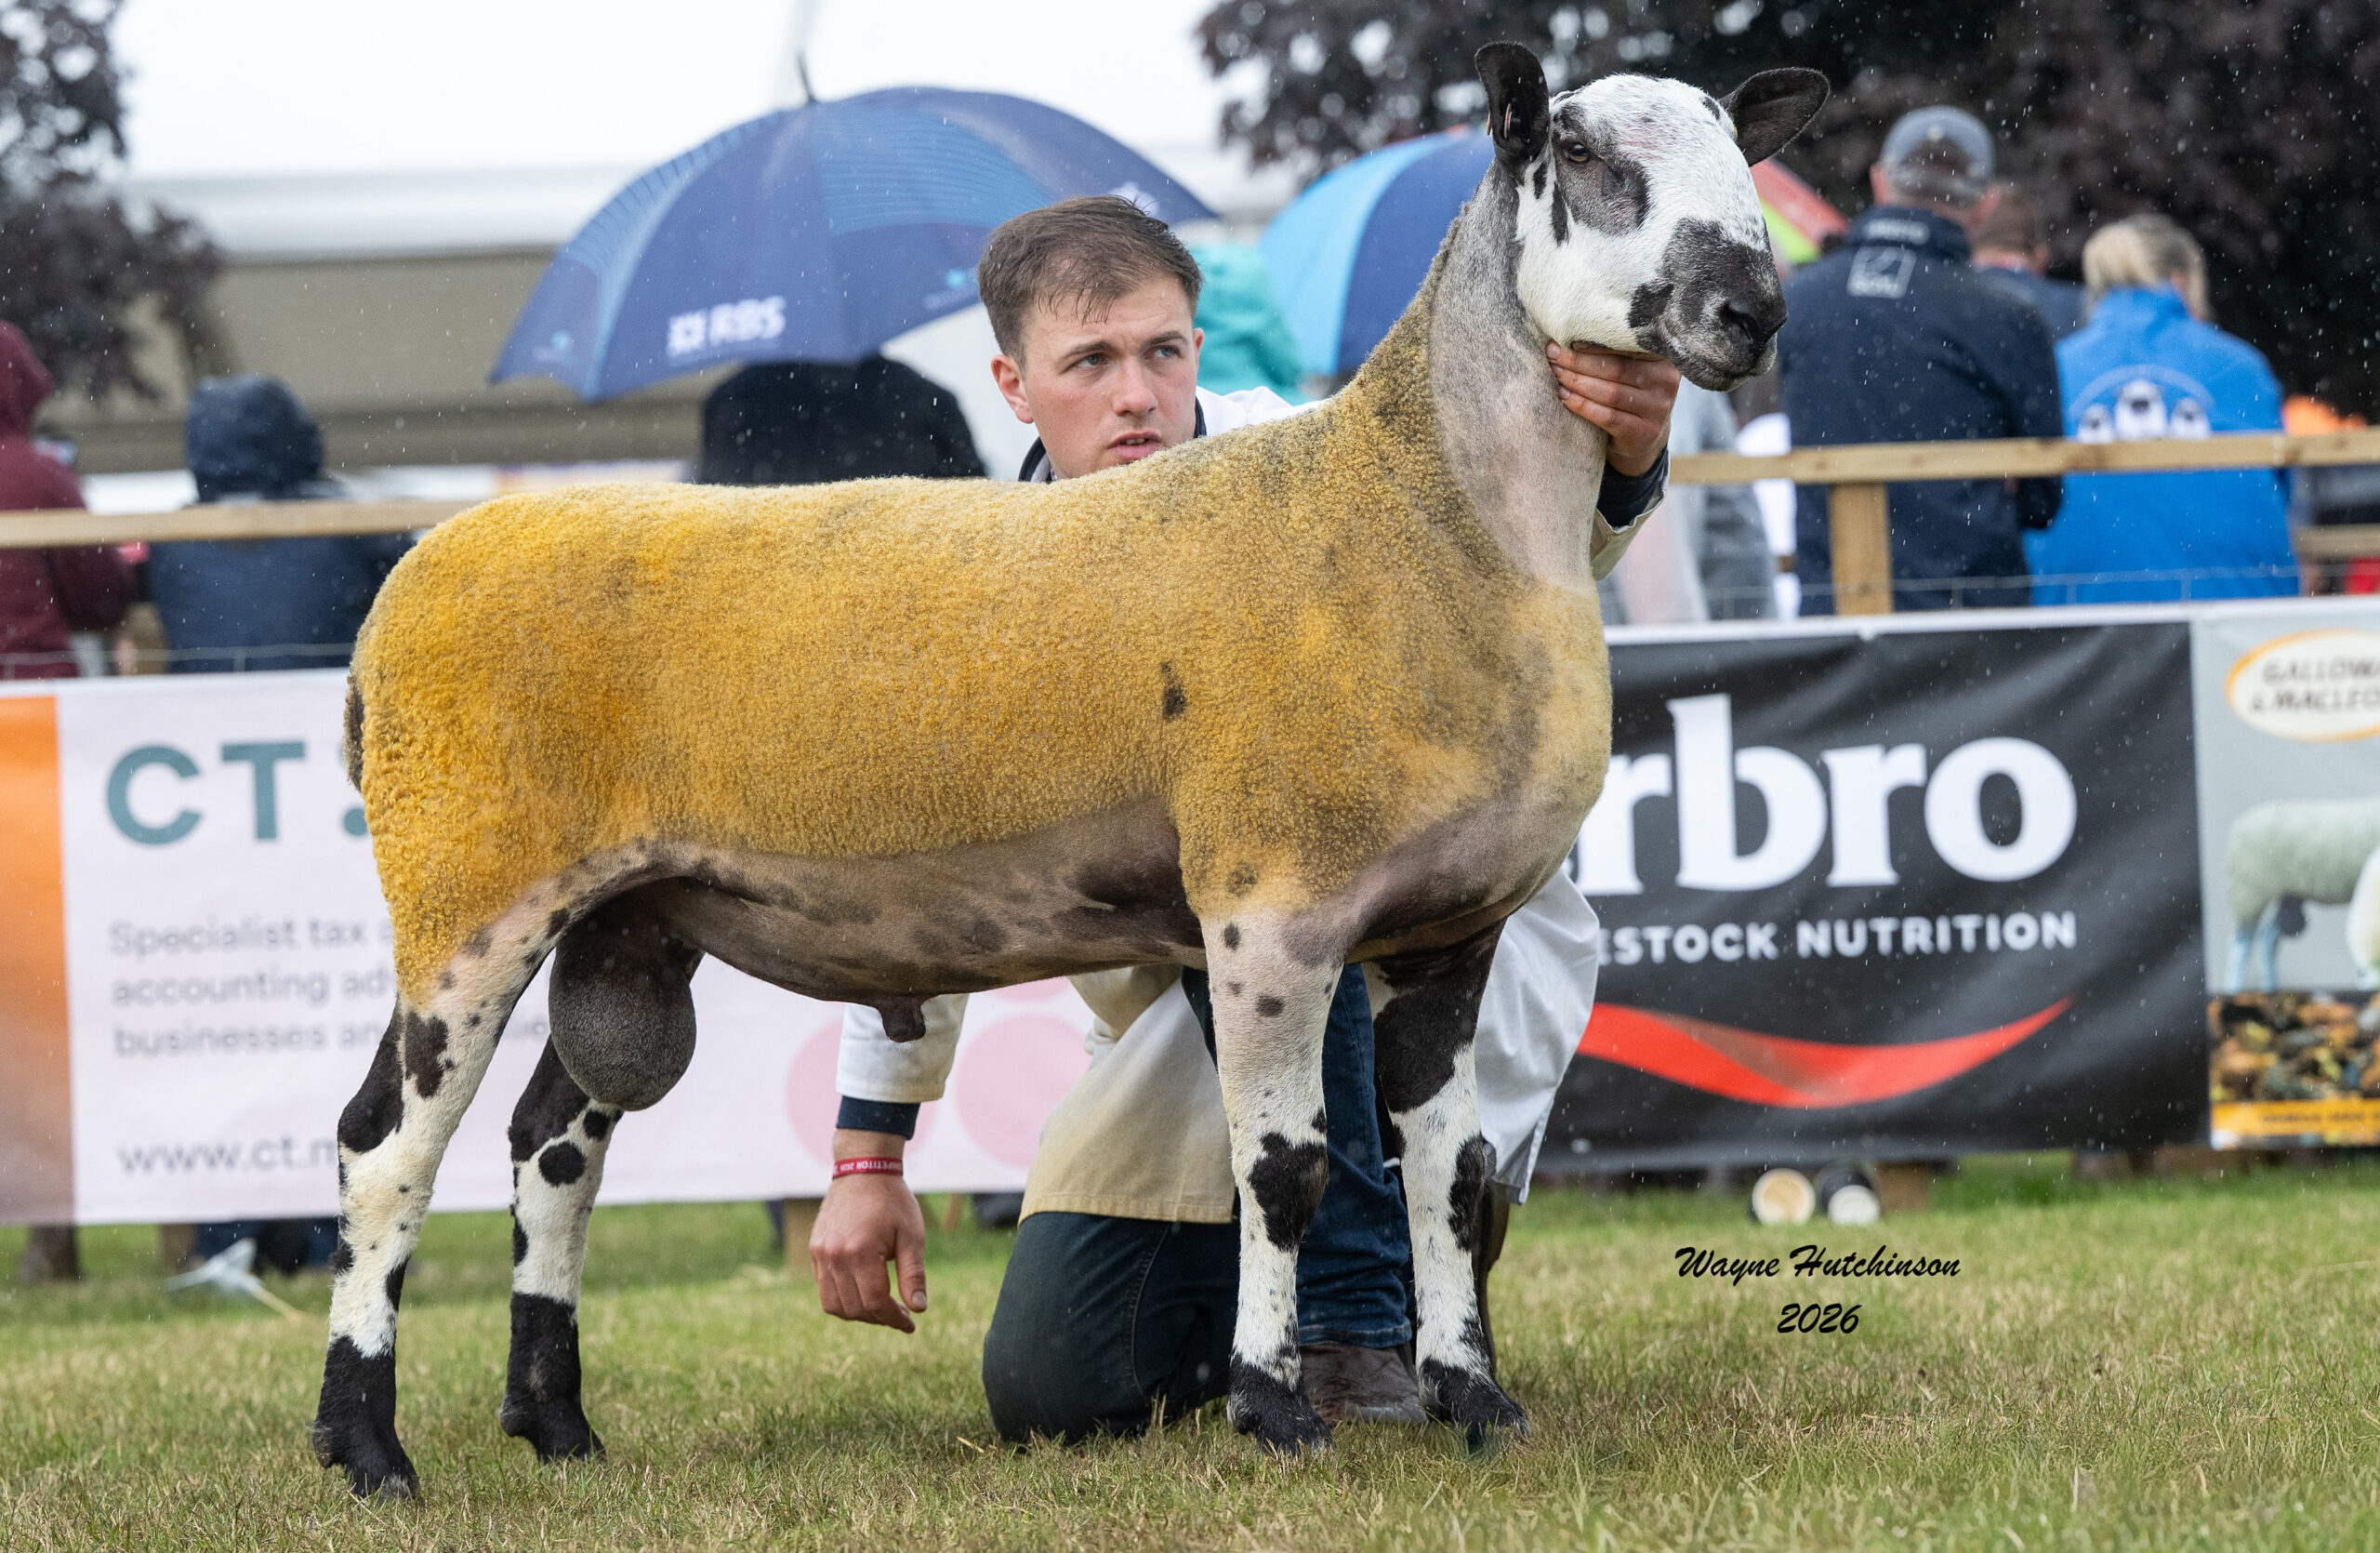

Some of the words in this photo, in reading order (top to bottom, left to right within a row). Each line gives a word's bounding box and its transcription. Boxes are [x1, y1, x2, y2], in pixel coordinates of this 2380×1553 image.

[2275, 686, 2380, 712] MACLEO
[1566, 693, 2078, 896] rbro
[111, 916, 297, 960] Specialist
[309, 918, 367, 947] tax
[1796, 910, 2078, 959] NUTRITION
[111, 967, 330, 1008] accounting
[113, 1020, 325, 1056] businesses
[338, 1021, 388, 1050] an
[117, 1131, 337, 1175] www.ct.m
